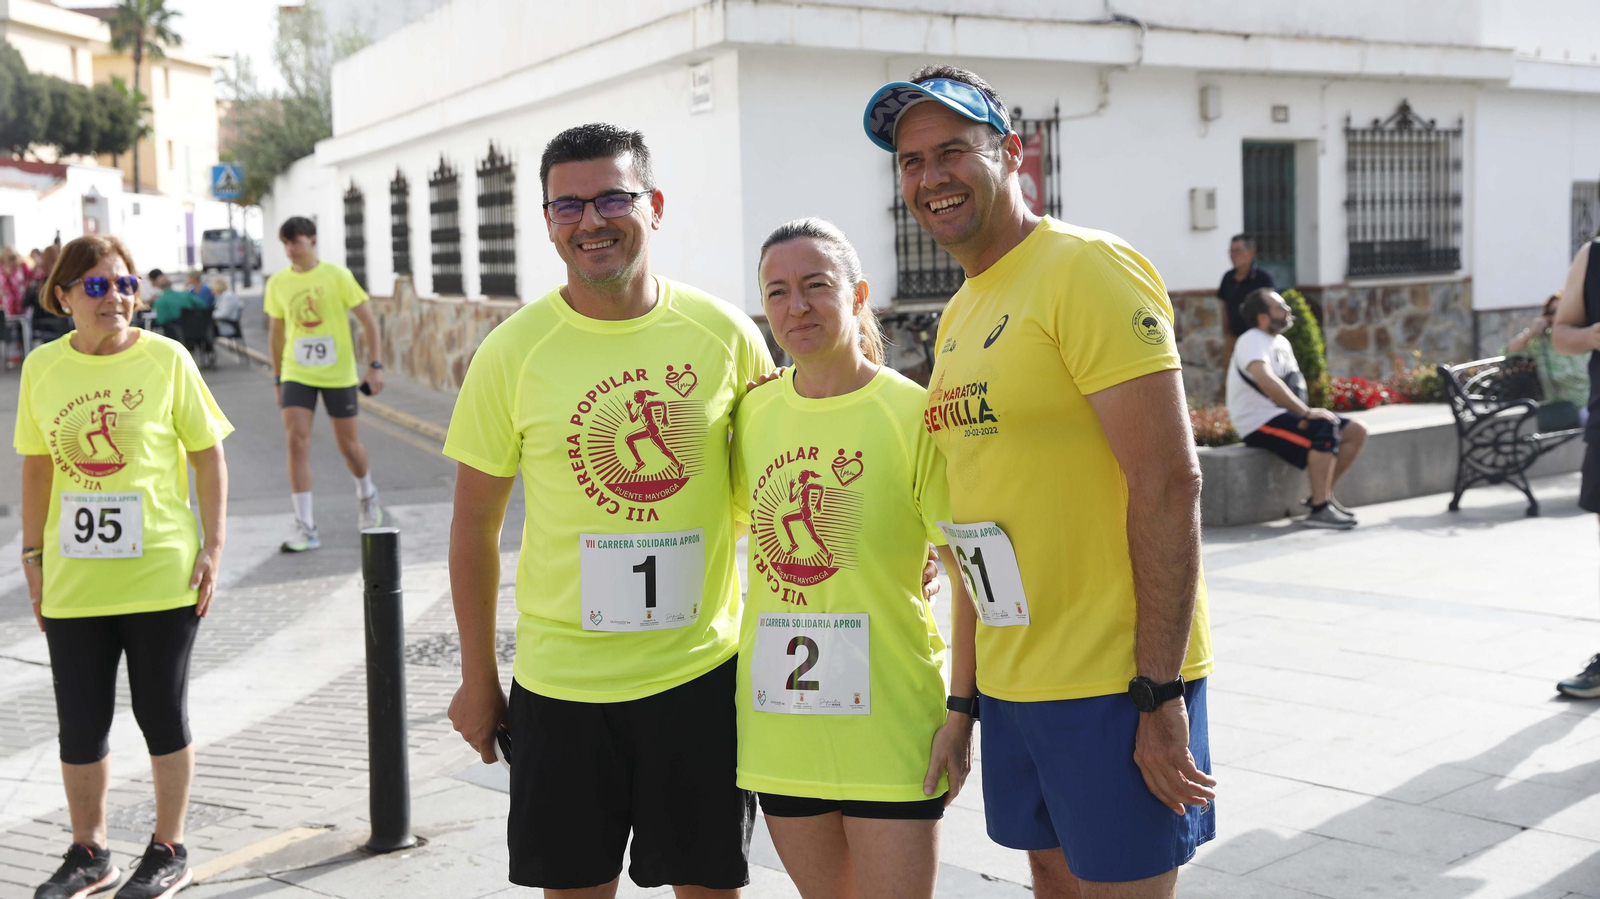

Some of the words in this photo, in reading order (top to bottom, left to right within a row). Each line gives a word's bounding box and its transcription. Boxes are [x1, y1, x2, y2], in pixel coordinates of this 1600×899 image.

[302, 343, 327, 360] 79
[570, 368, 649, 427] POPULAR
[943, 380, 988, 402] MARATÓN
[54, 389, 111, 425] POPULAR
[924, 397, 998, 434] SEVILLA
[964, 427, 999, 437] 20-02-2022
[566, 433, 621, 515] CARRERA
[752, 446, 819, 501] POPULAR
[83, 479, 102, 491] VII
[614, 486, 643, 501] PUENTE
[645, 483, 680, 501] MAYORGA
[626, 506, 660, 522] VII
[74, 507, 122, 544] 95
[980, 526, 1002, 538] APRON
[585, 539, 596, 549] VII
[597, 539, 634, 549] CARRERA
[636, 537, 678, 549] SOLIDARIA
[679, 534, 700, 546] APRON
[632, 555, 657, 608] 1
[797, 571, 829, 585] MAYORGA
[955, 545, 995, 603] 61
[781, 587, 808, 606] VII
[765, 618, 790, 627] CARRERA
[791, 619, 831, 628] SOLIDARIA
[833, 619, 862, 628] APRON
[785, 635, 820, 690] 2
